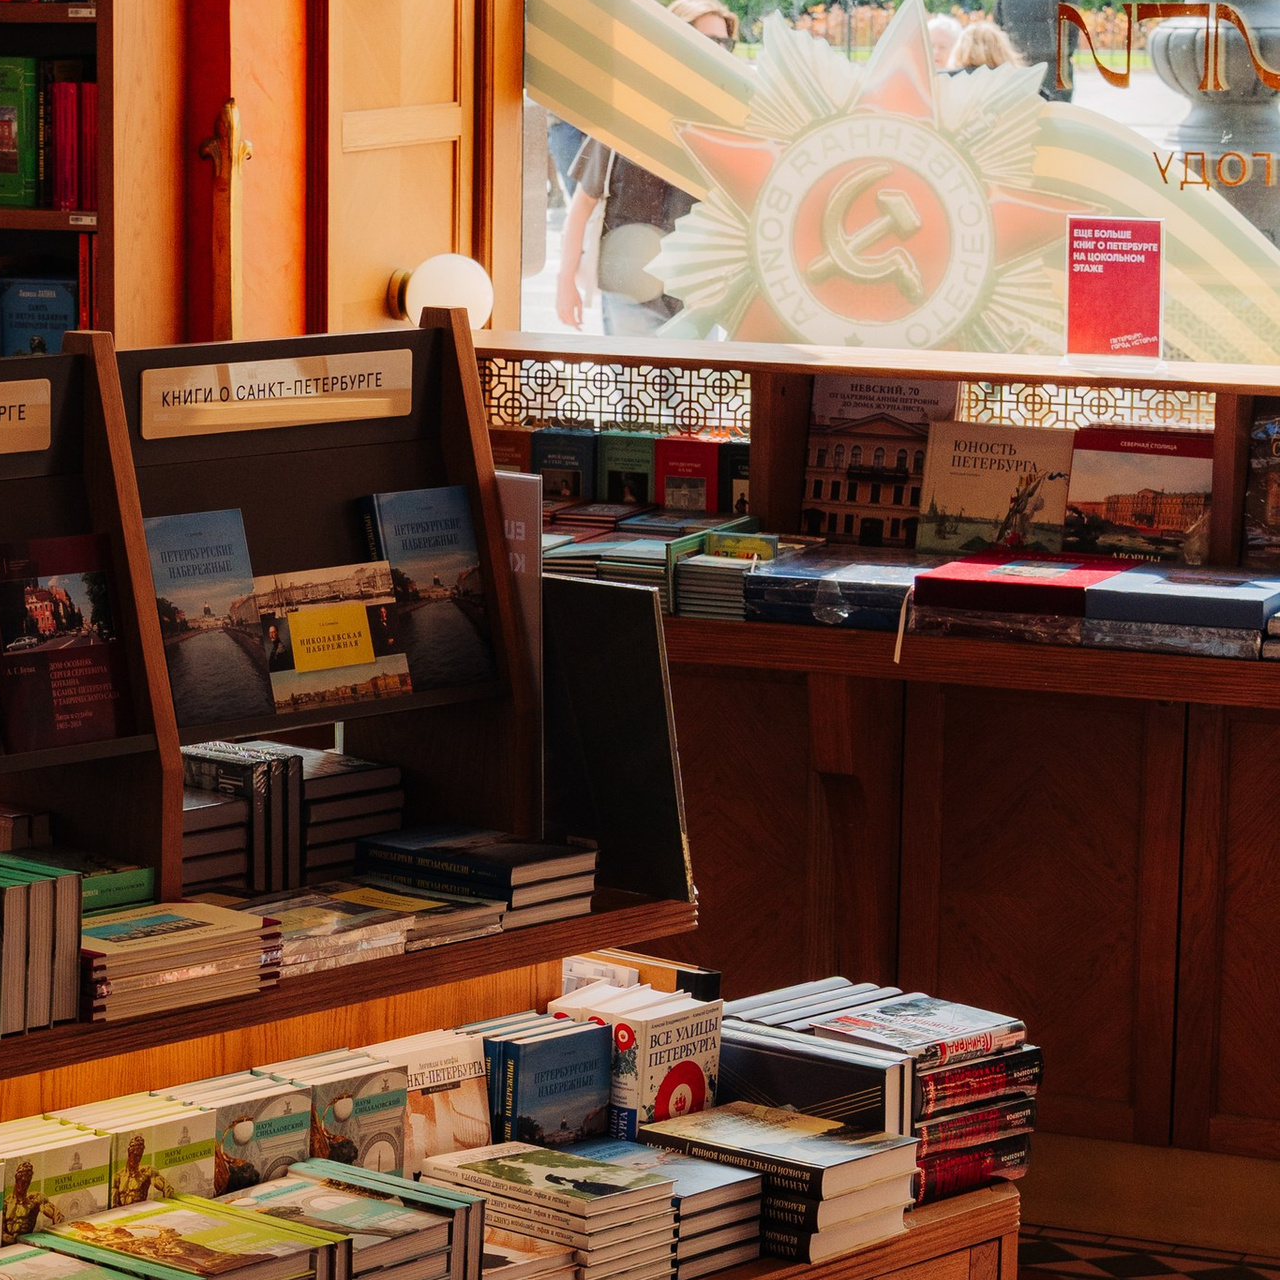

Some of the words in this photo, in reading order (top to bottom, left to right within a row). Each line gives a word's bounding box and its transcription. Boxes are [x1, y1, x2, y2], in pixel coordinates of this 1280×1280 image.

[1073, 228, 1093, 239] ЕЩЕ
[1094, 229, 1132, 240] БОЛЬШЕ
[1073, 240, 1095, 251] КНИГ
[1097, 241, 1105, 251] О
[1106, 242, 1159, 253] ПЕТЕРБУРГЕ
[1073, 252, 1086, 262] НА
[1087, 252, 1145, 265] ЦОКОЛЬНОМ
[1073, 264, 1104, 274] ЭТАЖЕ
[161, 387, 213, 407] КНИГИ
[219, 384, 231, 403] О
[235, 371, 384, 401] САНКТ-ПЕТЕРБУРГЕ
[850, 383, 903, 396] НЕВСКИЙ,
[954, 439, 1018, 456] ЮНОСТЬ
[951, 456, 1039, 474] ПЕТЕРБУРГА
[394, 517, 461, 536] ПЕТЕРБУРГСКИЕ
[401, 533, 460, 551] НАБЕРЕЖНЫЕ
[161, 543, 234, 564] ПЕТЕРБУРГСКИЕ
[169, 559, 233, 579] НАБЕРЕЖНЫЕ
[299, 630, 363, 647] НИКОЛАЕВСКАЯ
[305, 639, 360, 654] НАБЕРЕЖНАЯ
[649, 1030, 674, 1050] ВСЕ
[676, 1017, 719, 1044] УЛИЦЫ
[648, 1038, 718, 1069] ПЕТЕРБУРГА
[534, 1057, 601, 1085] ПЕТЕРБУРГСКИЕ
[537, 1074, 595, 1099] НАБЕРЕЖНЫЕ
[355, 1097, 372, 1108] НАУМ
[355, 1096, 402, 1115] СИНДАЛОВСКИЙ
[256, 1121, 273, 1132] НАУМ
[256, 1120, 304, 1138] СИНДАЛОВСКИЙ
[164, 1148, 182, 1159] НАУМ
[164, 1147, 212, 1166] СИНДАЛОВСКИЙ
[54, 1175, 73, 1186] НАУМ
[54, 1175, 106, 1193] СИНДАЛОВСКИЙ
